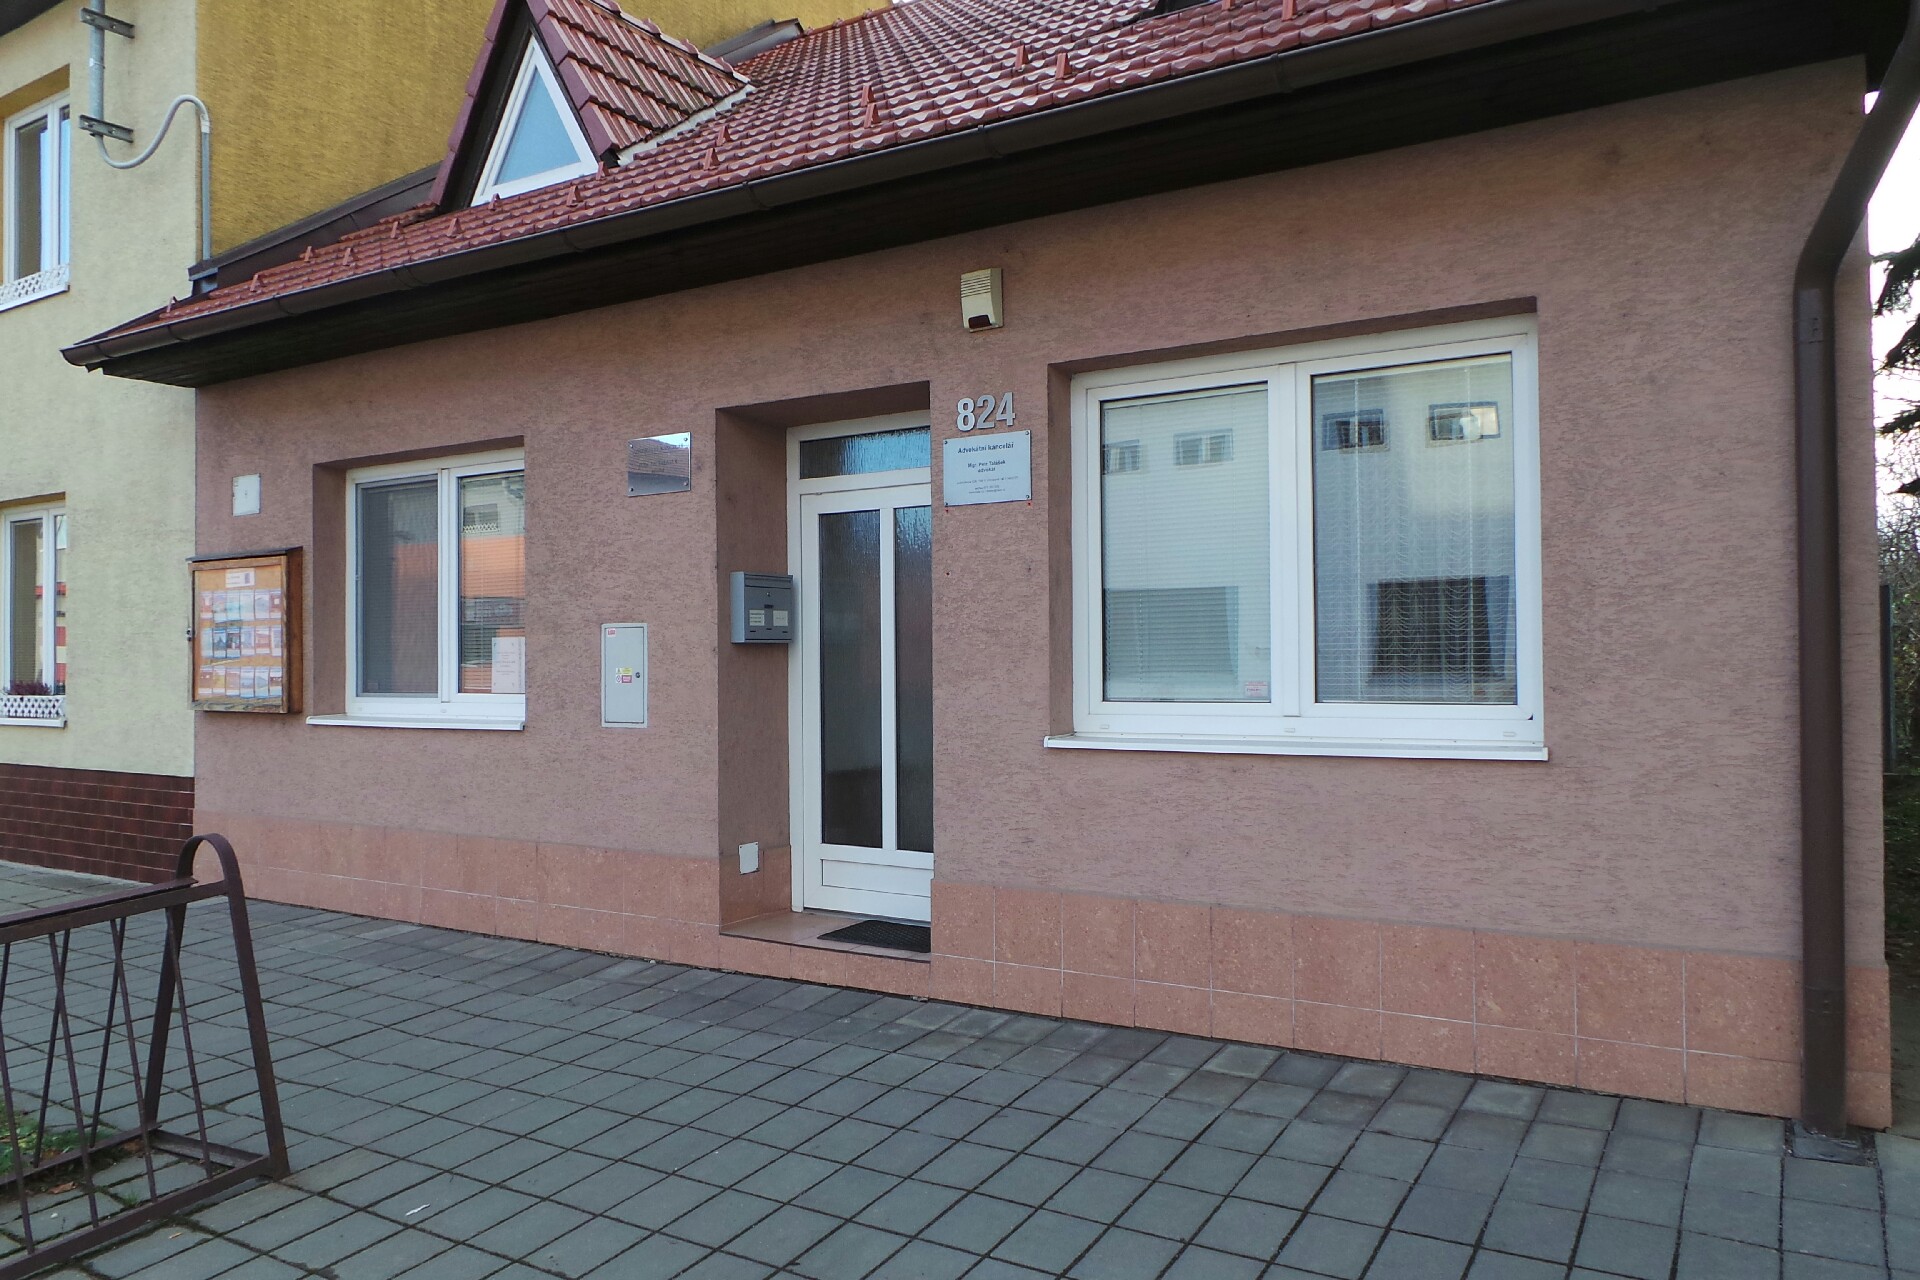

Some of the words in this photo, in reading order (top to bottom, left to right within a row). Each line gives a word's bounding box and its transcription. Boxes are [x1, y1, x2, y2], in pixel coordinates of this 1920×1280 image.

[957, 392, 1016, 431] 824
[958, 444, 986, 454] Advokátní
[988, 442, 1014, 450] kancelář
